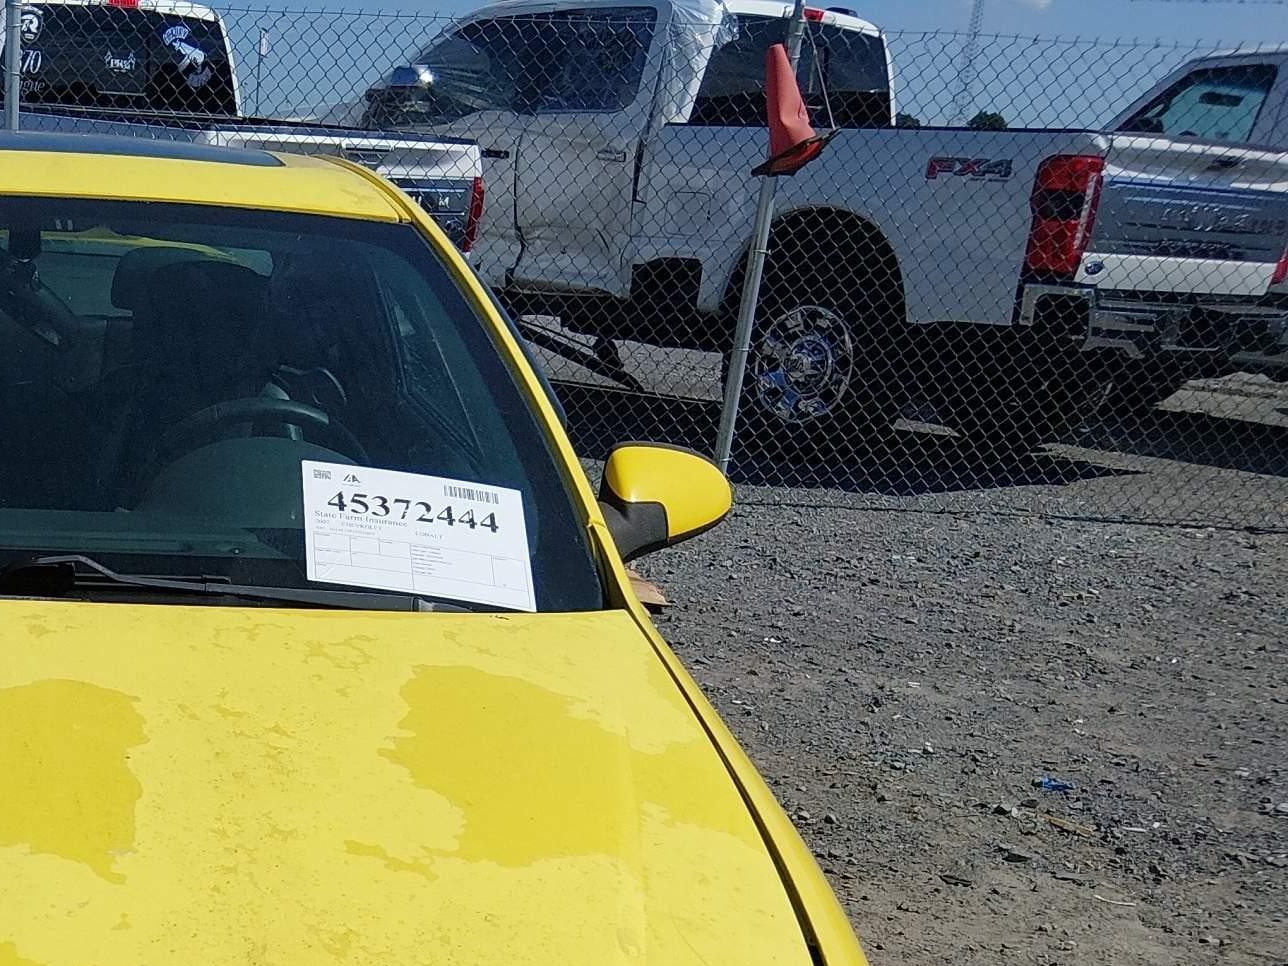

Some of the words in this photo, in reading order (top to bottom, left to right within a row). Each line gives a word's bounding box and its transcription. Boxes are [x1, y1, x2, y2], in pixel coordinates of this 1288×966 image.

[925, 156, 1012, 179] FX4
[314, 510, 336, 519] State
[365, 515, 409, 527] Insurance
[327, 490, 500, 533] 45372444
